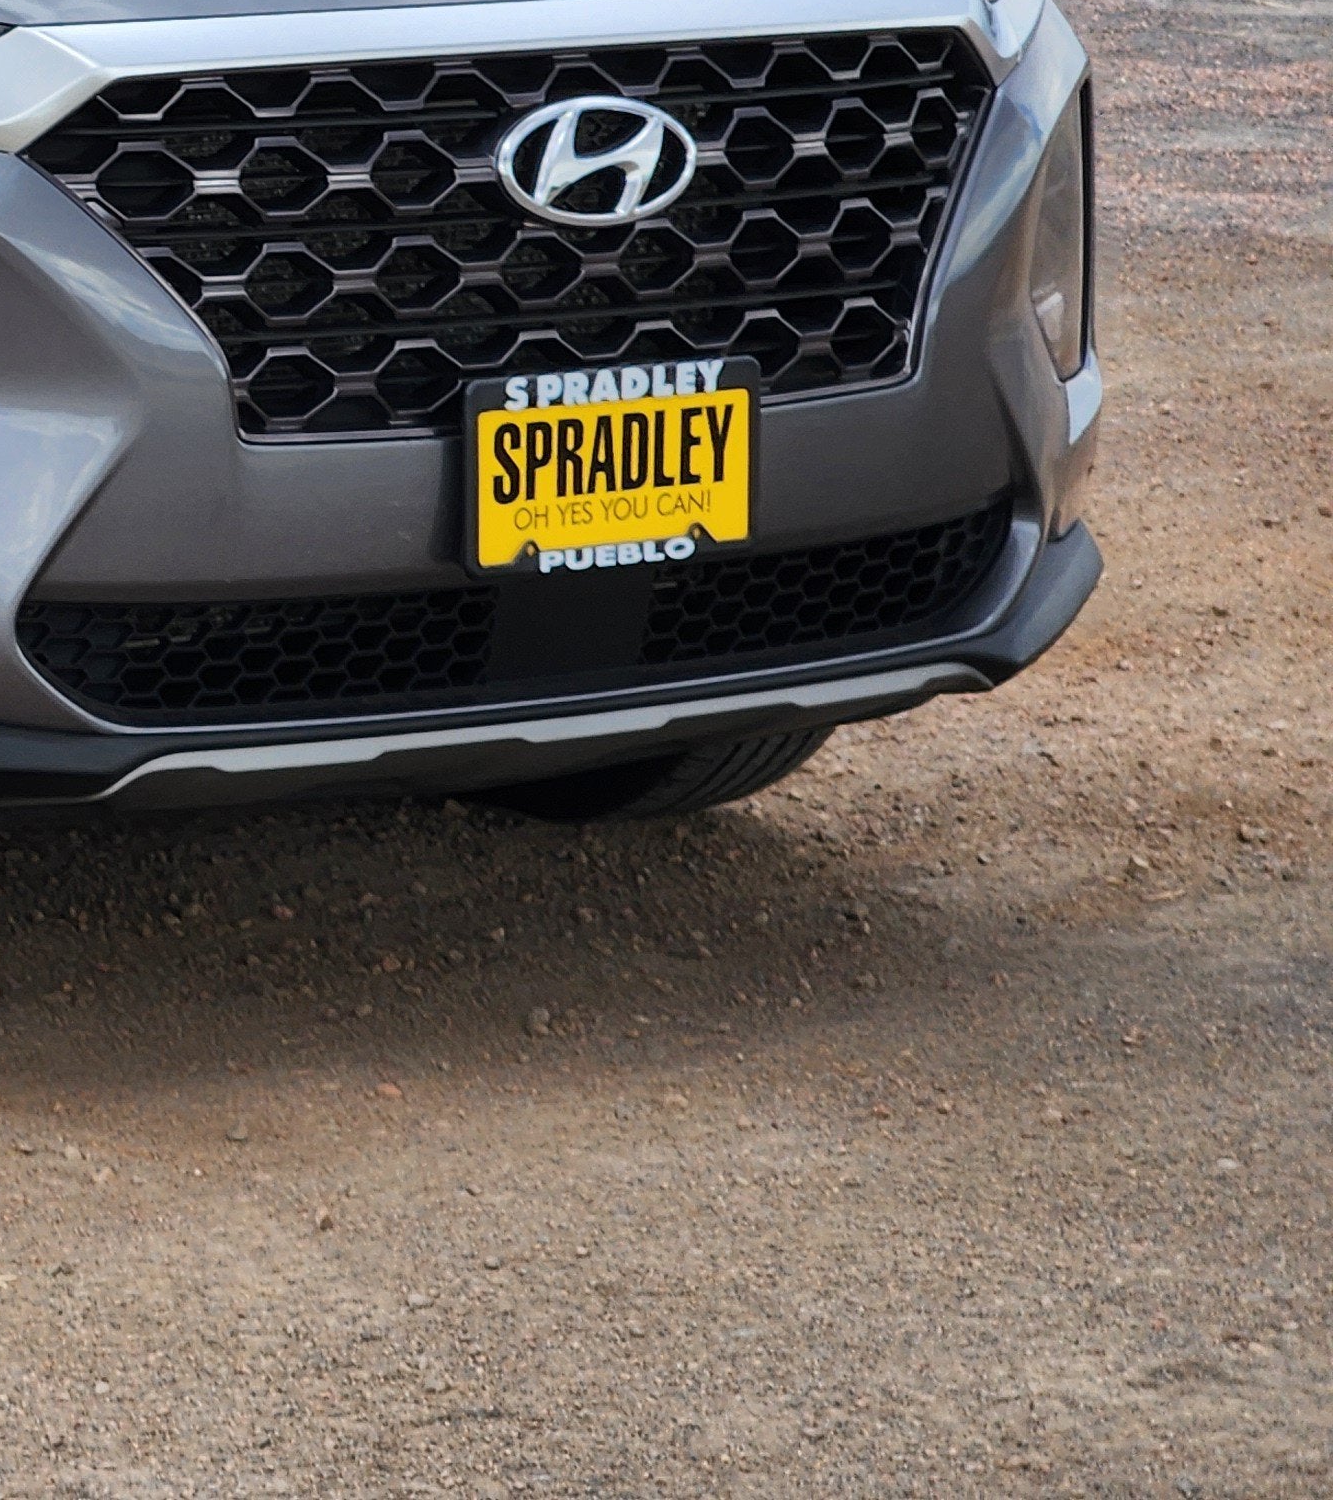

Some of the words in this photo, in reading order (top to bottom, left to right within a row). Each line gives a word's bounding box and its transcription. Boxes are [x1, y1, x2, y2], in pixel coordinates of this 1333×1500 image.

[503, 359, 725, 411] SPRADLEY
[493, 404, 734, 505] SPRADLEY
[514, 505, 549, 530] OH
[557, 501, 594, 527] YES
[600, 496, 648, 522] YOU
[656, 489, 711, 516] CAN!
[538, 536, 696, 574] PUEBLO
